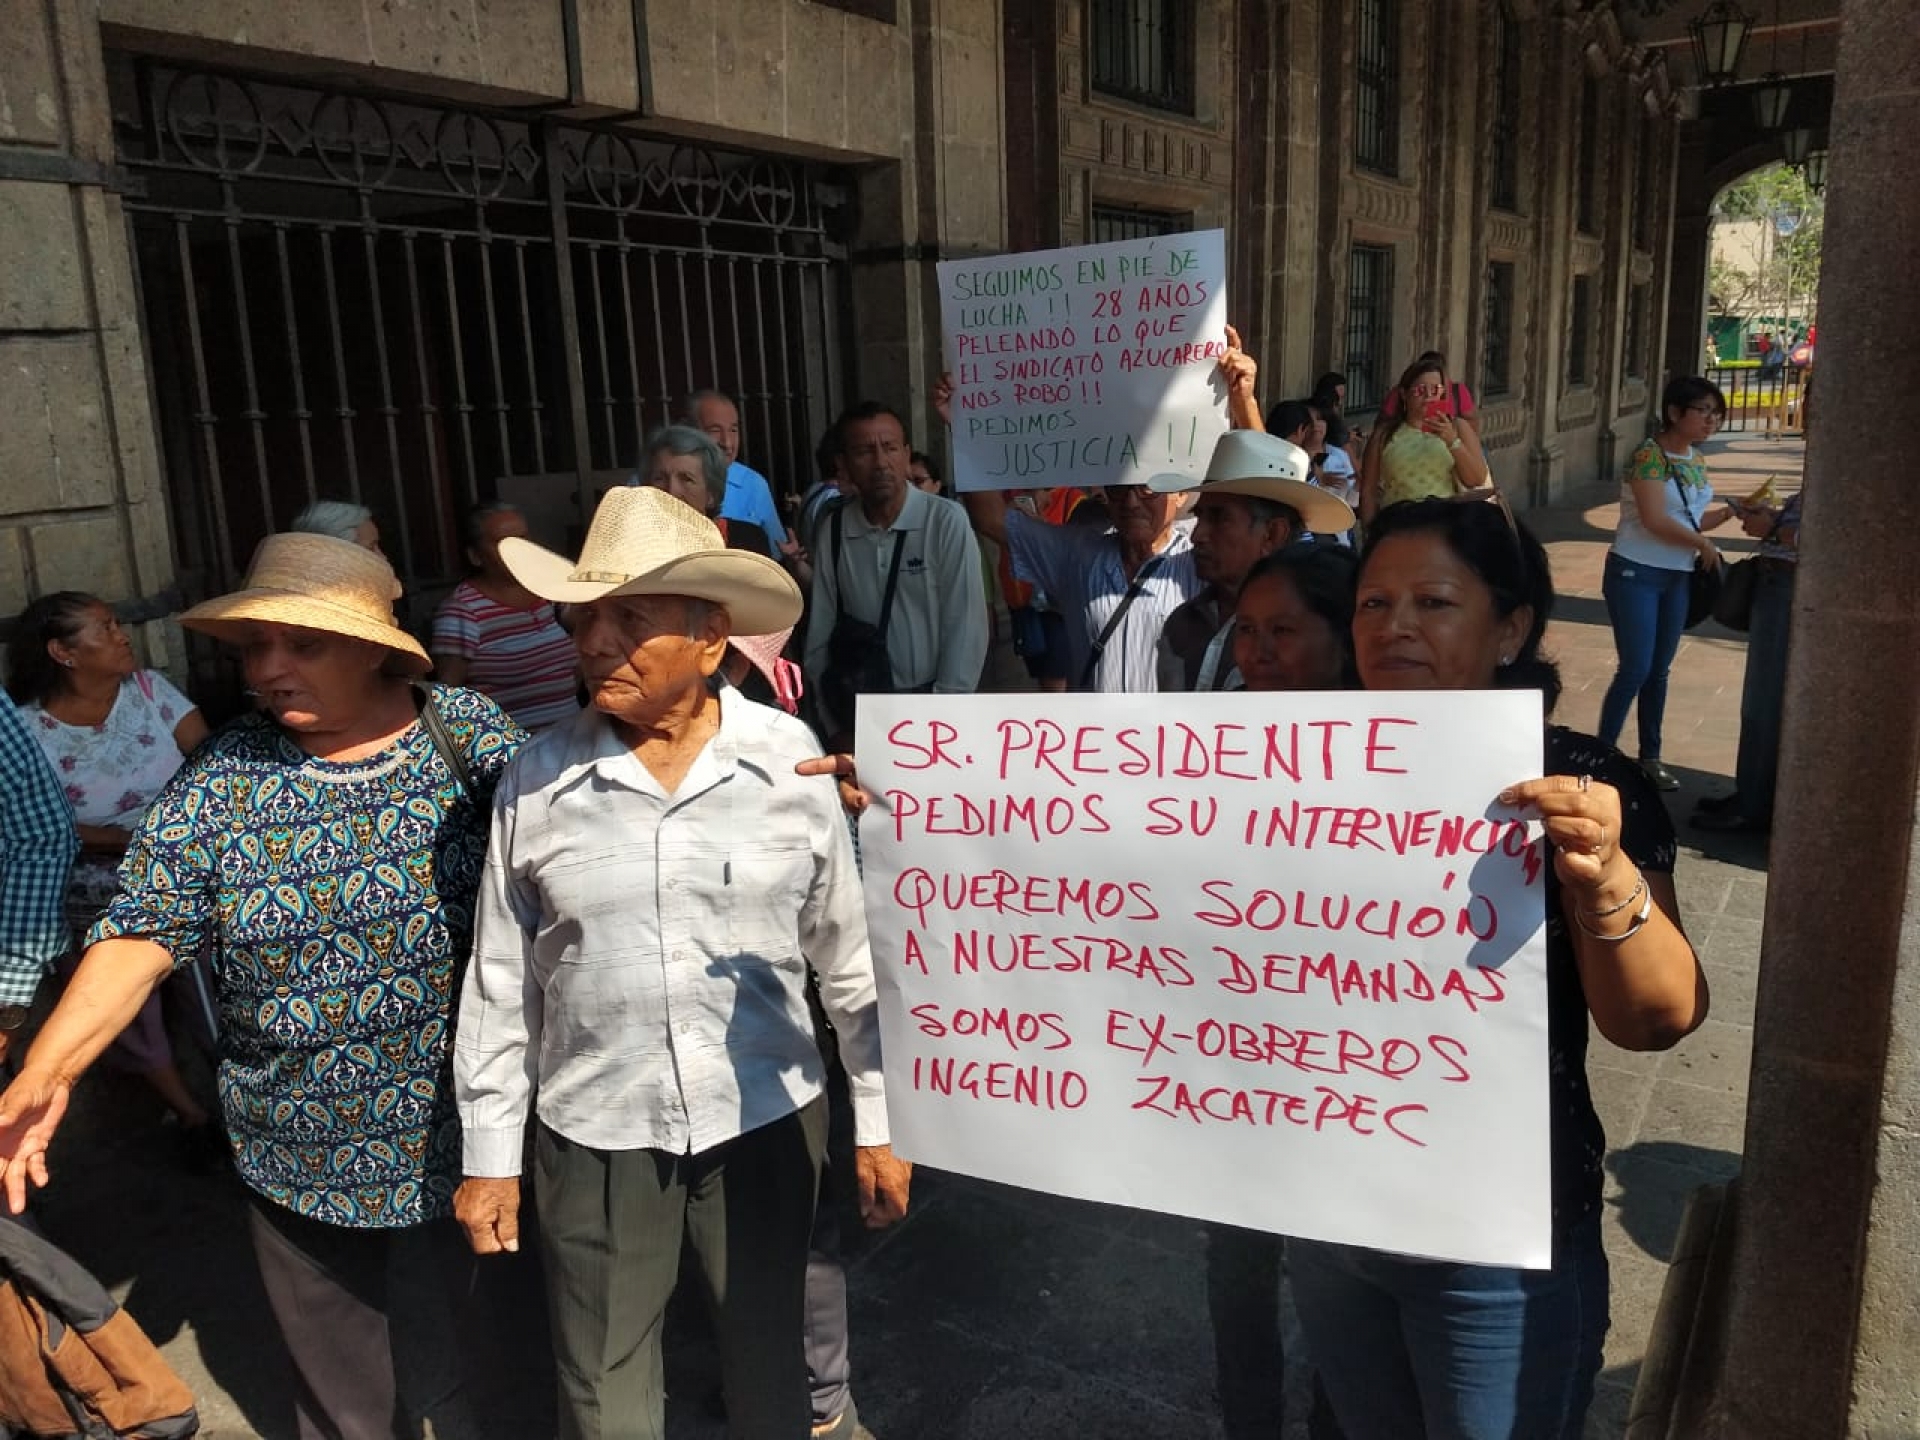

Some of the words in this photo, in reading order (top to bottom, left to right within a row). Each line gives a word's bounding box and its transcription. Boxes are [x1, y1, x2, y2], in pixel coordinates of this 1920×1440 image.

[953, 264, 1063, 300] SEGUIMOS
[1077, 257, 1105, 284] EN
[1164, 250, 1200, 277] DE
[961, 304, 1028, 328] LUCHA
[1091, 292, 1122, 318] 28
[1138, 279, 1207, 312] AÑOS
[956, 326, 1075, 357] PELEANDO
[1094, 324, 1121, 344] LO
[1135, 314, 1188, 348] QUE
[960, 362, 985, 384] EL
[995, 351, 1104, 382] SINDICATO
[1119, 341, 1224, 373] AZUCARERO
[961, 389, 1001, 409] NOS
[966, 410, 1079, 438] PEDIMOS
[985, 433, 1139, 476] JUSTICIA
[887, 720, 974, 769] SR.
[997, 717, 1418, 786] PRESIDENTE
[885, 790, 1111, 843] PEDIMOS
[1145, 796, 1217, 837] SU
[894, 867, 1160, 930] QUEREMOS
[1194, 872, 1498, 942] SOLUCIÓN
[905, 929, 929, 975] A
[953, 929, 1195, 987] NUESTRAS
[1212, 946, 1506, 1012] DEMANDAS
[910, 1004, 1072, 1050] SOMOS
[1105, 1009, 1471, 1081] EX-OBREROS
[914, 1057, 1087, 1110] INGENIO
[1131, 1076, 1429, 1146] ZACATEPEC
